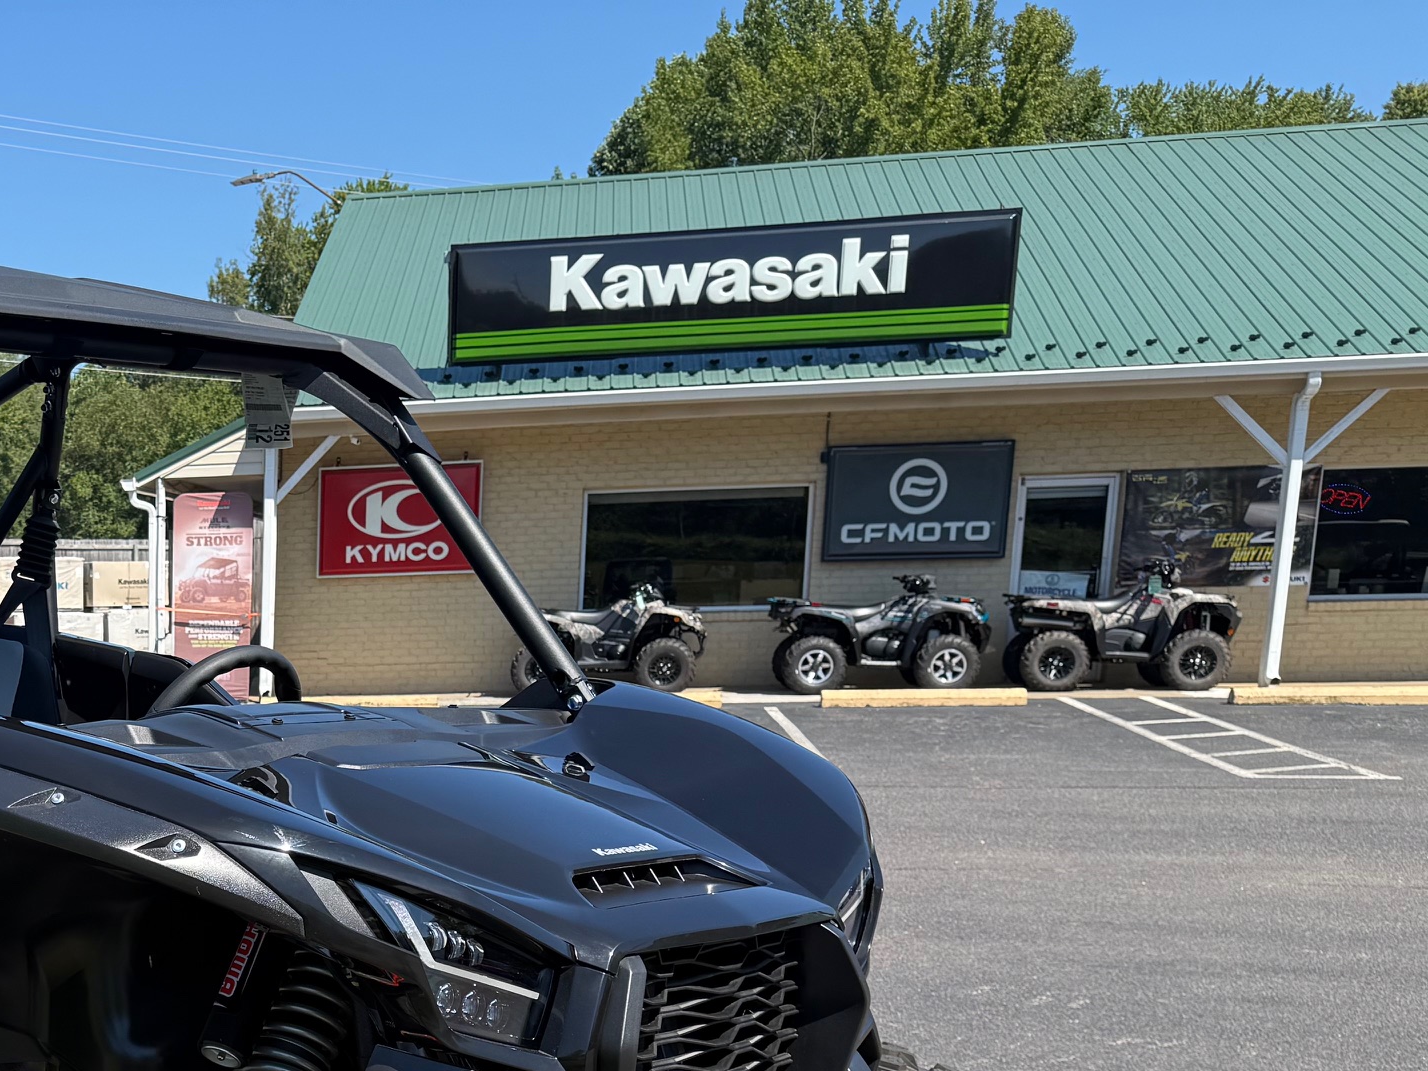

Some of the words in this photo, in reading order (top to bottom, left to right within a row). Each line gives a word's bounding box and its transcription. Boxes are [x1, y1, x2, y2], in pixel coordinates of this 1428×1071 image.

[549, 234, 910, 312] Kawasaki
[274, 424, 290, 442] 251
[186, 536, 243, 546] STRONG
[840, 521, 991, 543] CFMOTO
[1212, 532, 1254, 548] READY
[345, 541, 449, 564] KYMCO
[592, 843, 659, 857] Kawasaki
